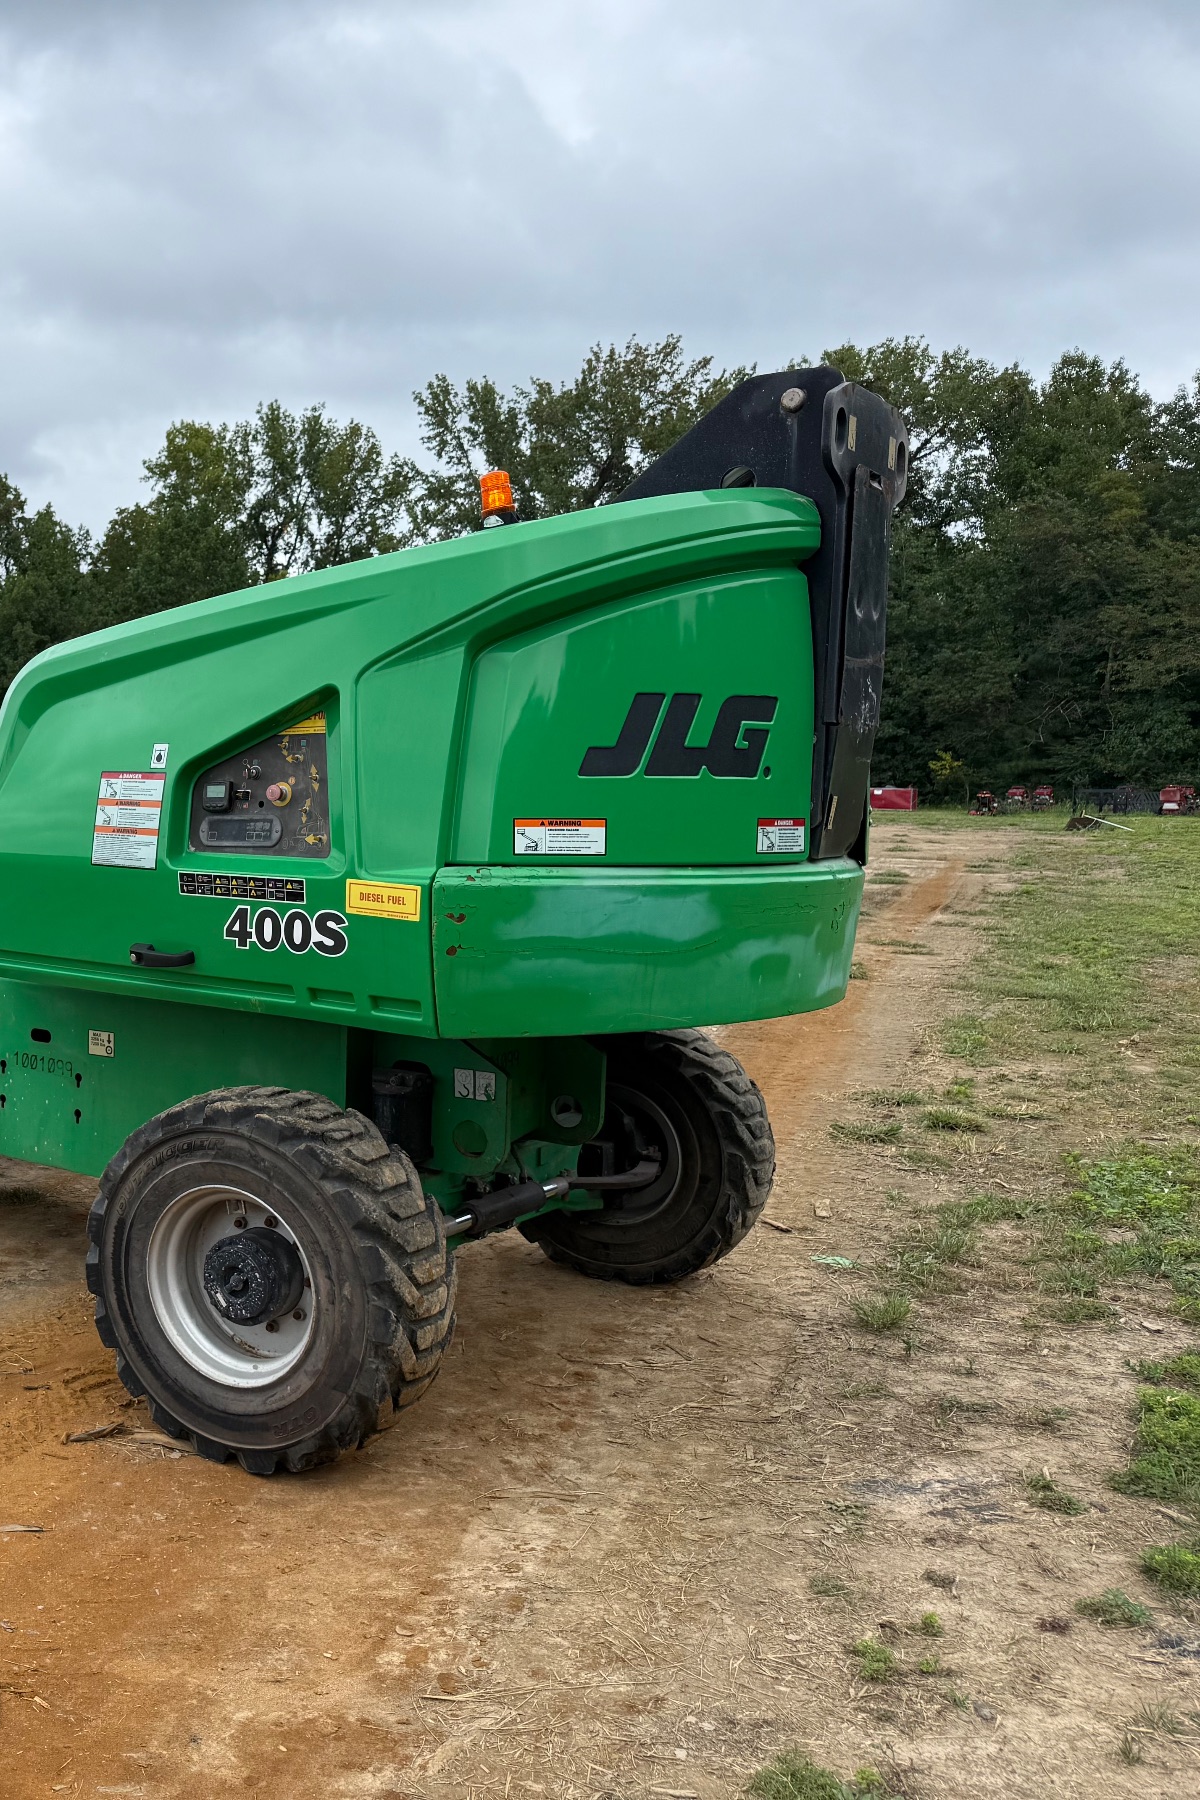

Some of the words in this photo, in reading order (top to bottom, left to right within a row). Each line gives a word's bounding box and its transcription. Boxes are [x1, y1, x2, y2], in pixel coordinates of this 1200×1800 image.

[578, 692, 778, 779] JLG
[359, 891, 385, 904] DIESEL
[387, 894, 407, 906] FUEL
[224, 905, 348, 957] 400S
[13, 1051, 73, 1077] 1001099
[115, 1136, 226, 1217] OUTRIGGER
